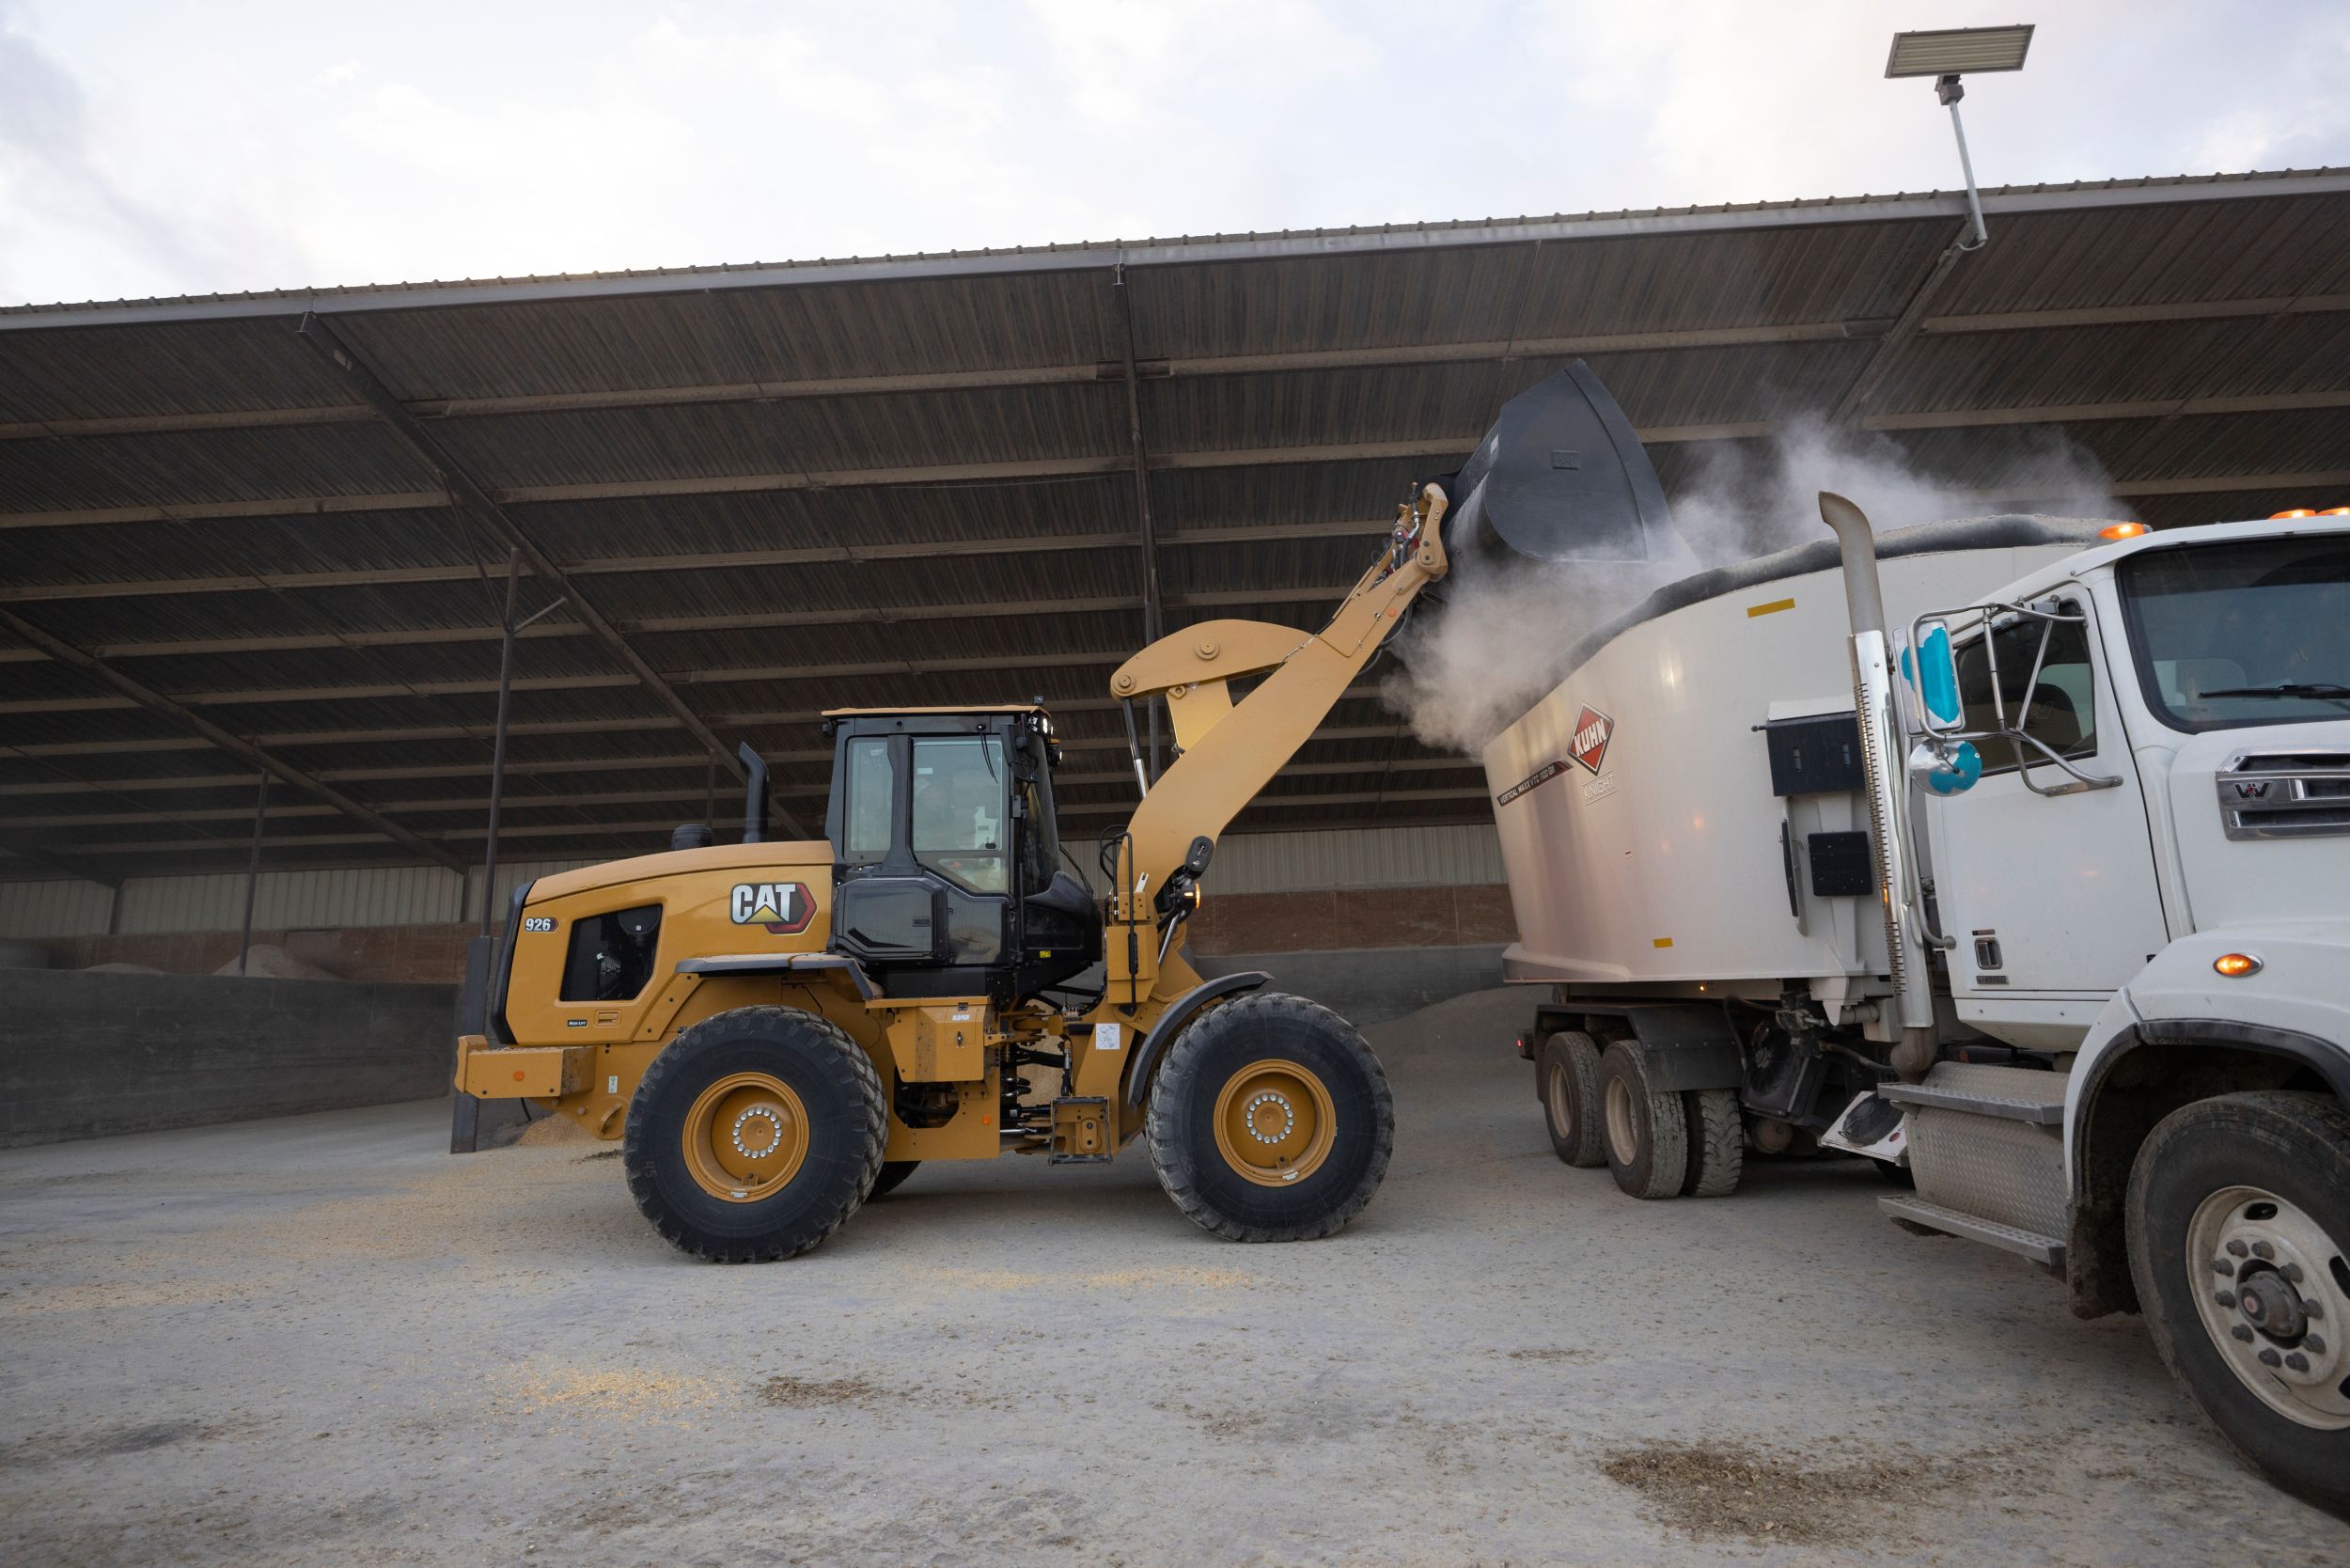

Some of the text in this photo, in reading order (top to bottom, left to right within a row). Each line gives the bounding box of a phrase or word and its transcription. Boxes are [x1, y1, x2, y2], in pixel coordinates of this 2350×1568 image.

[1574, 718, 1607, 757] KUHN
[1499, 789, 1518, 804] VERTICAL
[1517, 782, 1531, 793] MAXX
[1584, 774, 1615, 799] KNIGHT
[732, 884, 796, 923] CAT
[525, 917, 552, 932] 926
